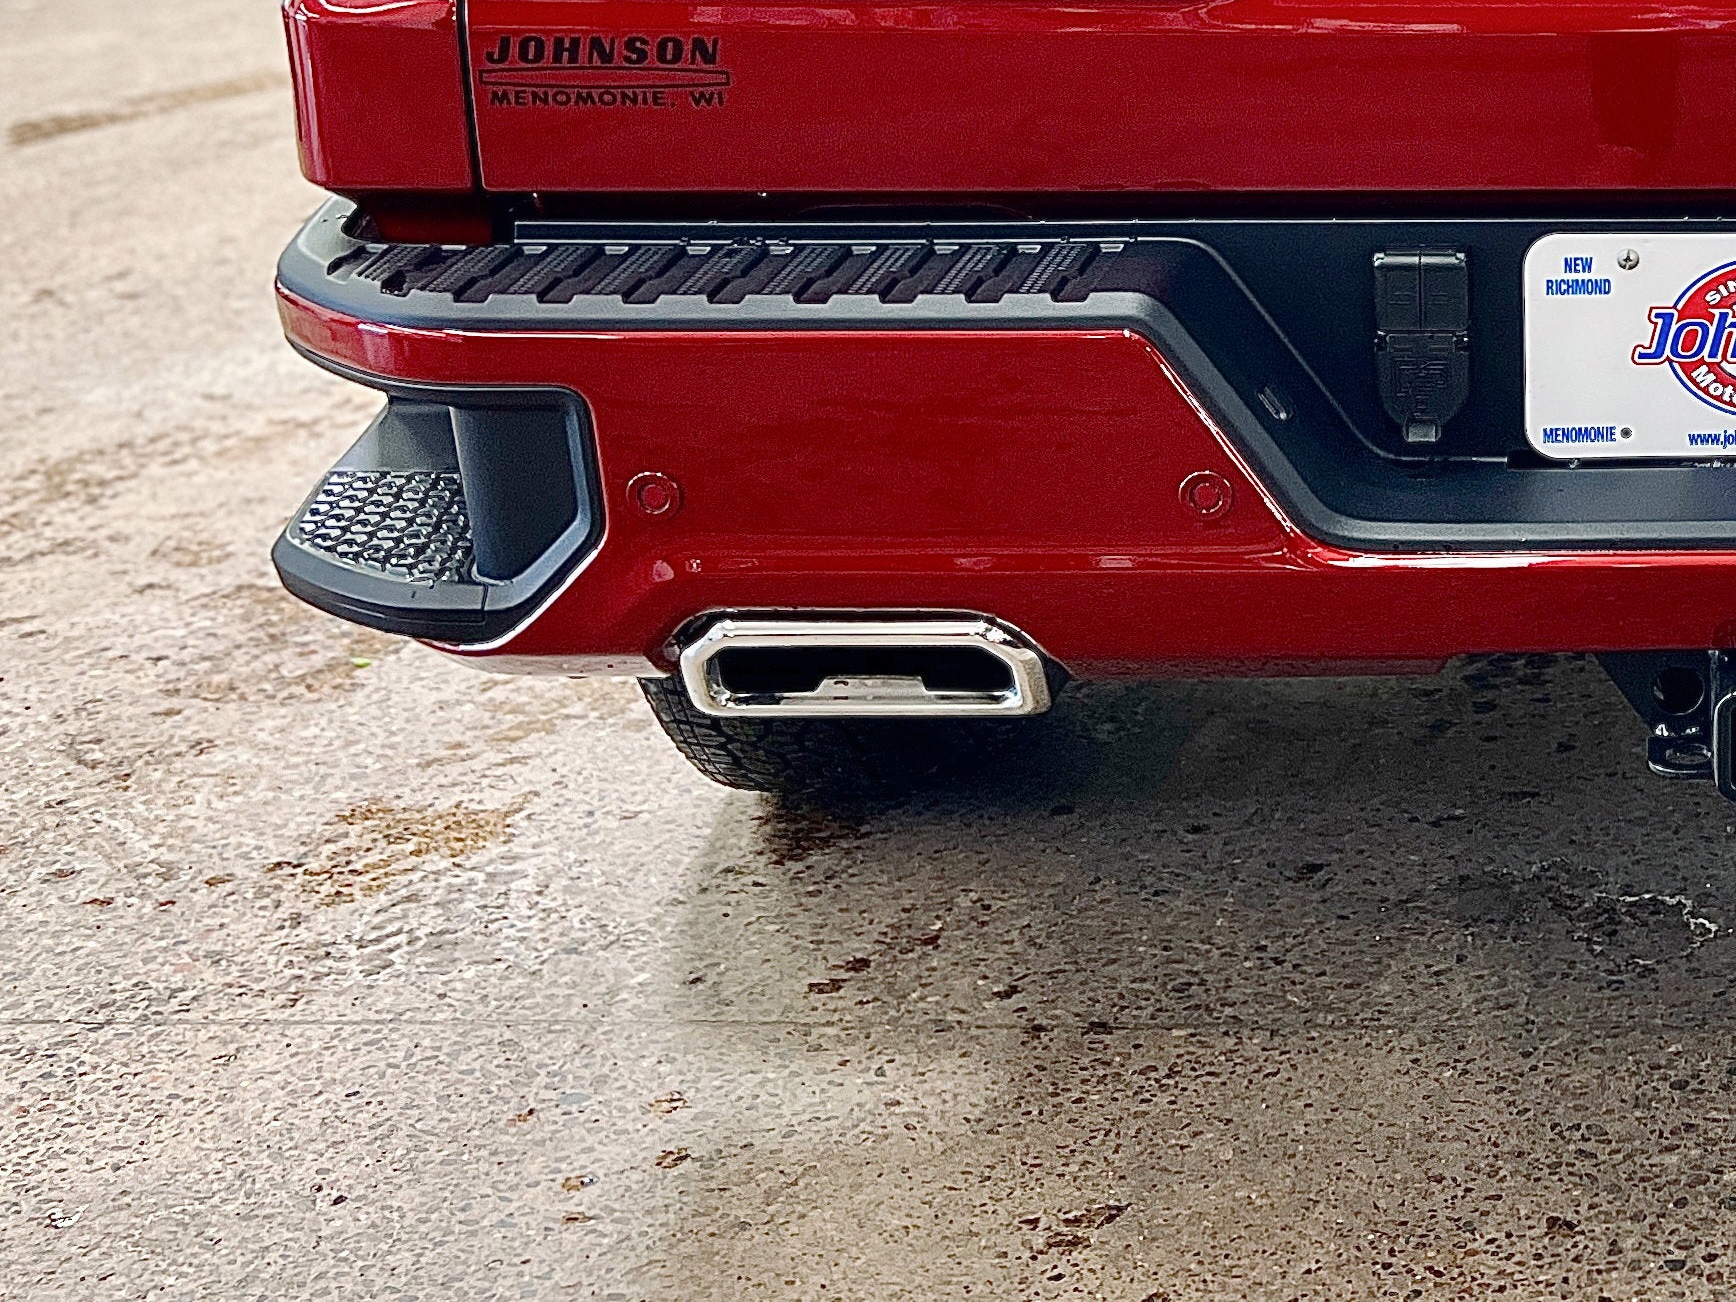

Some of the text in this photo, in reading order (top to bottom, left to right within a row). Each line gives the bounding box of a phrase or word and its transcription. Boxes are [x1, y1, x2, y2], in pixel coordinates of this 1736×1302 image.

[485, 35, 719, 65] JOHNSON
[690, 91, 725, 107] WI
[1564, 256, 1594, 274] NEW
[1545, 278, 1612, 296] RICHMOND
[1542, 426, 1617, 444] MENOMONIE
